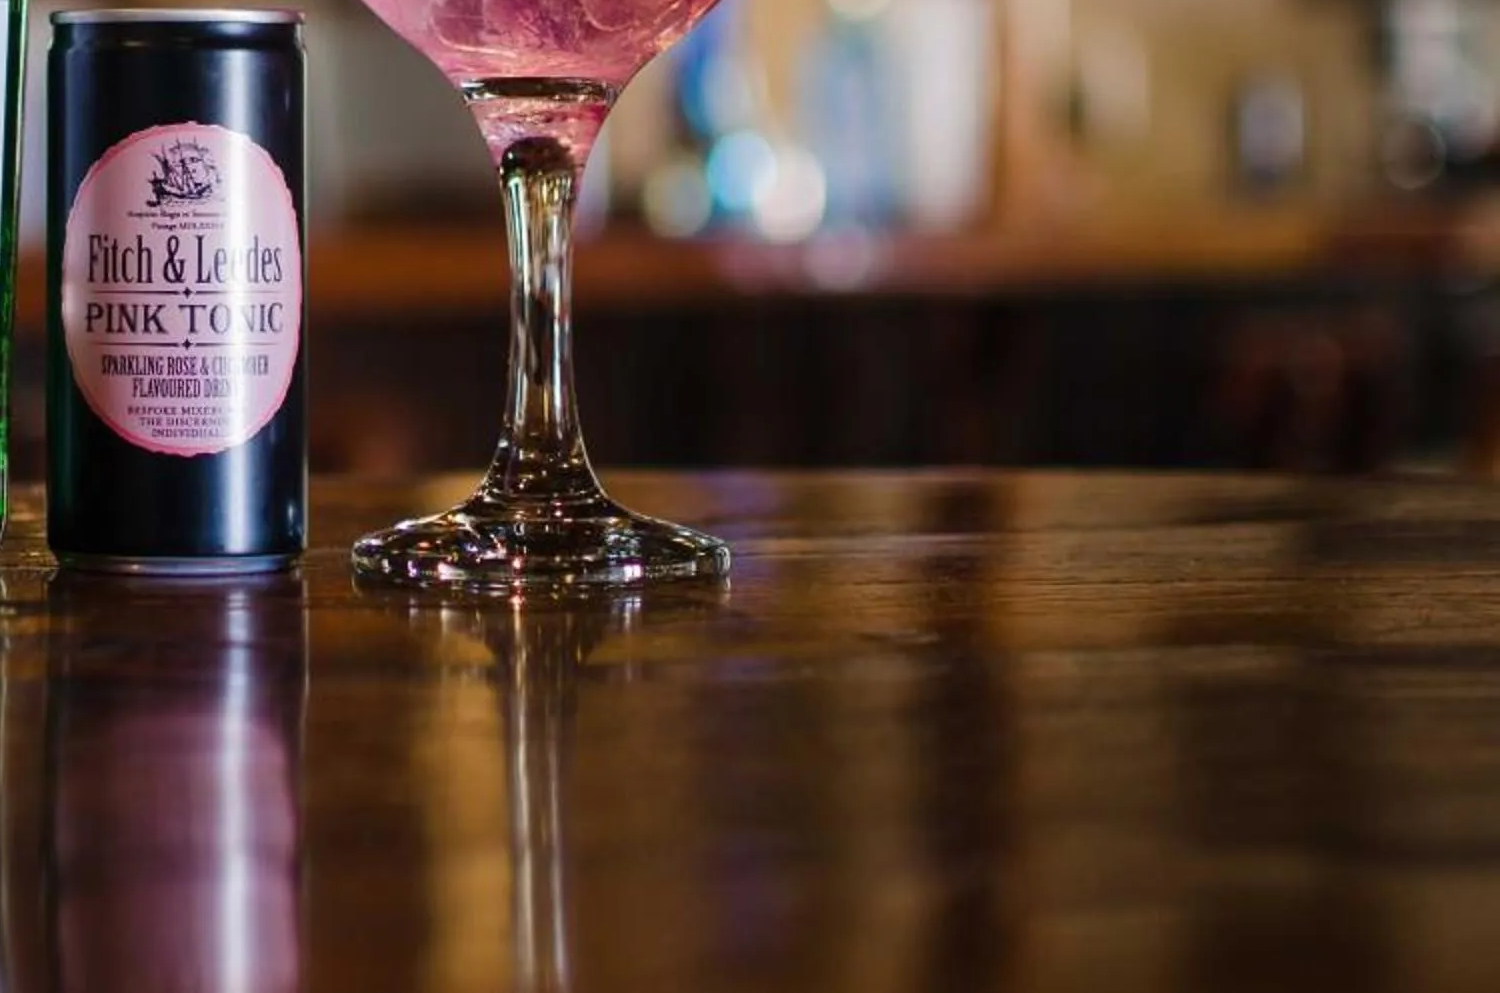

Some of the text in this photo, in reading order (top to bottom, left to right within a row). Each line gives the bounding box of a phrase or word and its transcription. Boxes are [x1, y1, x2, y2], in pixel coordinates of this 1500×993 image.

[87, 234, 152, 284] Fitch
[163, 234, 187, 283] &
[86, 304, 169, 335] PINK
[101, 355, 165, 376] SPARKLING
[167, 356, 197, 376] ROSE
[199, 357, 210, 376] &
[132, 378, 238, 398] FLAVOURED DRIN
